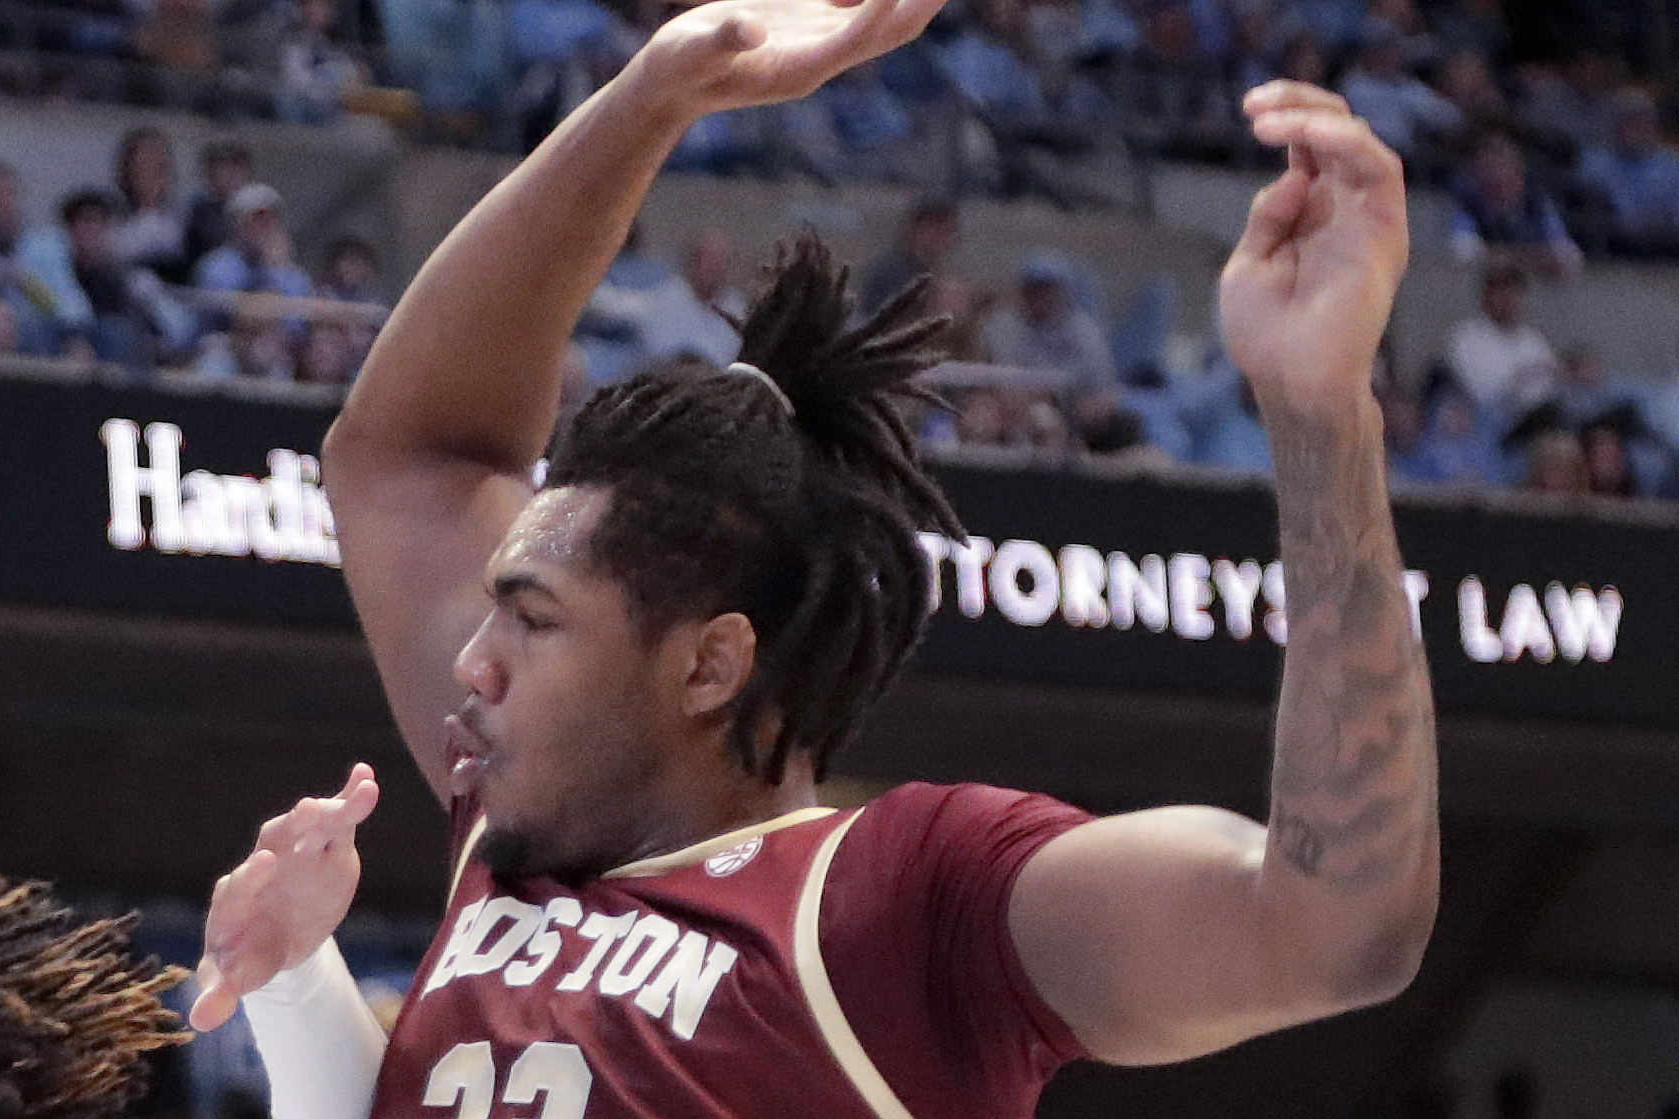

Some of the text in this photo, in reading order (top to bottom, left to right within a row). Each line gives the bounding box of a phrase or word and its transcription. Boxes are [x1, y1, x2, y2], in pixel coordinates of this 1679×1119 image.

[917, 530, 1289, 647] TTORNEYS
[1458, 574, 1623, 664] LAW
[420, 893, 738, 1040] BOSTON
